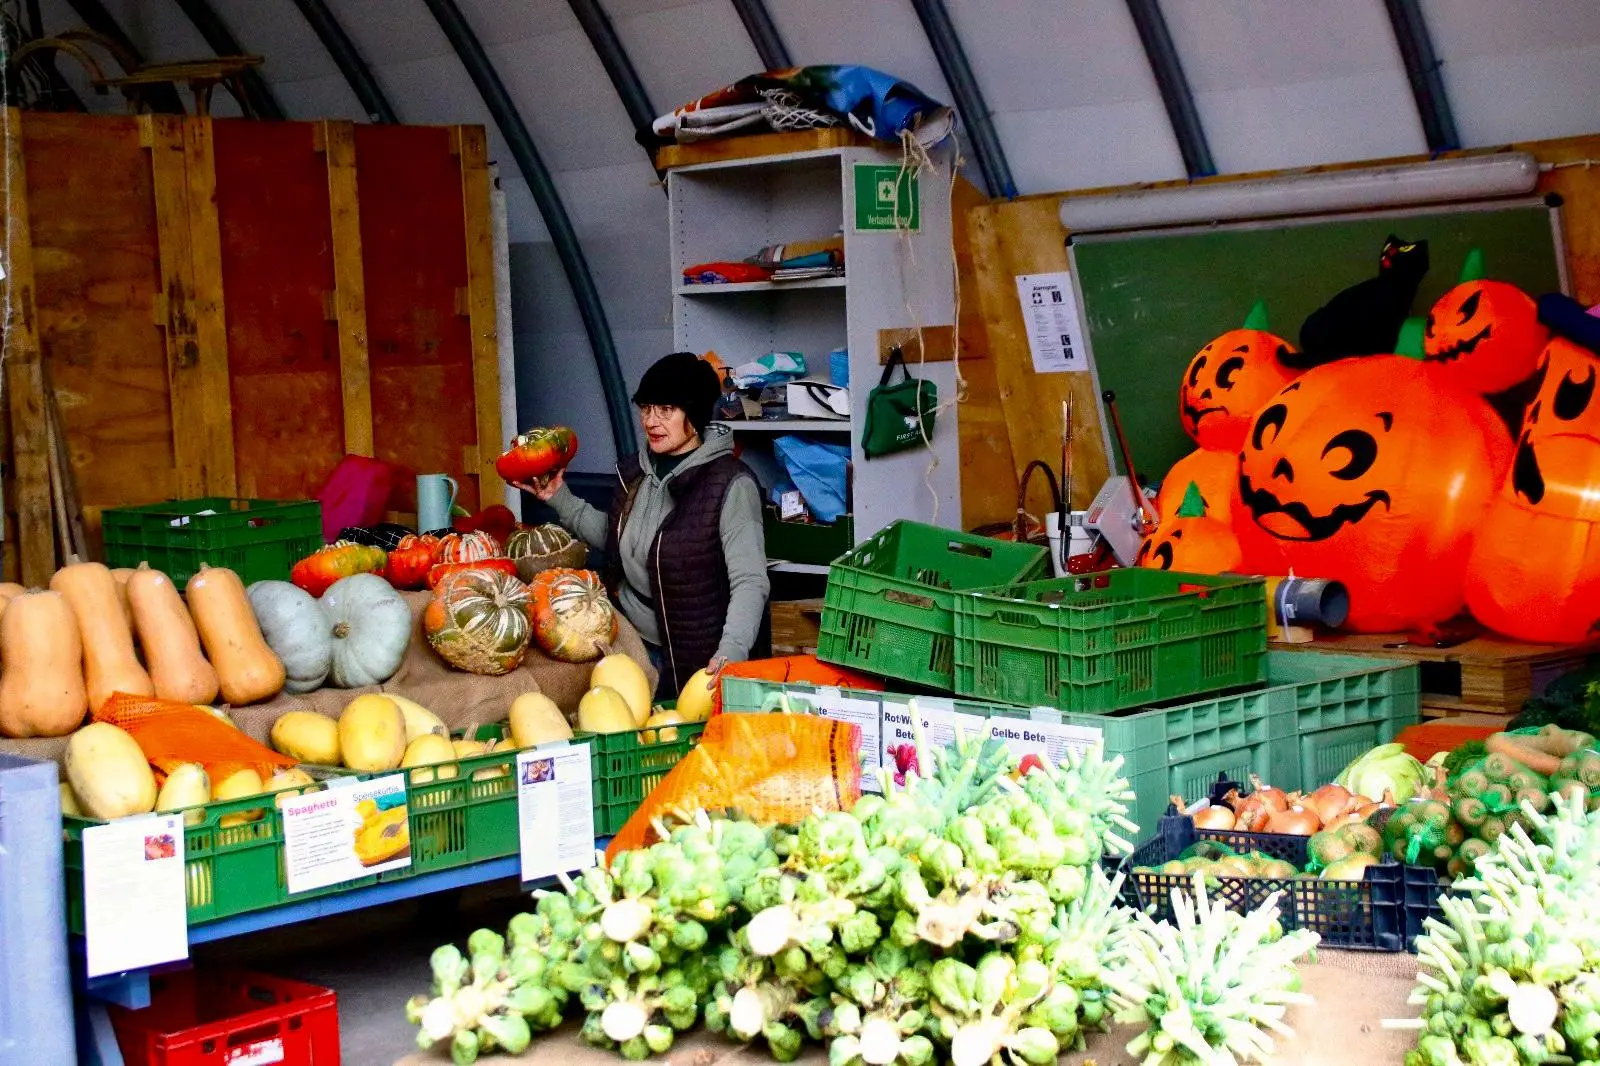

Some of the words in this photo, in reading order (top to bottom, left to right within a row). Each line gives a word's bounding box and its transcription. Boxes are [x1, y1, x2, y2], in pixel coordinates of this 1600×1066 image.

[868, 213, 908, 225] Verbandkaten
[896, 431, 913, 441] FIRST
[991, 726, 1020, 740] Gelbe
[1023, 730, 1046, 743] Bete
[287, 797, 337, 817] Spaghetti
